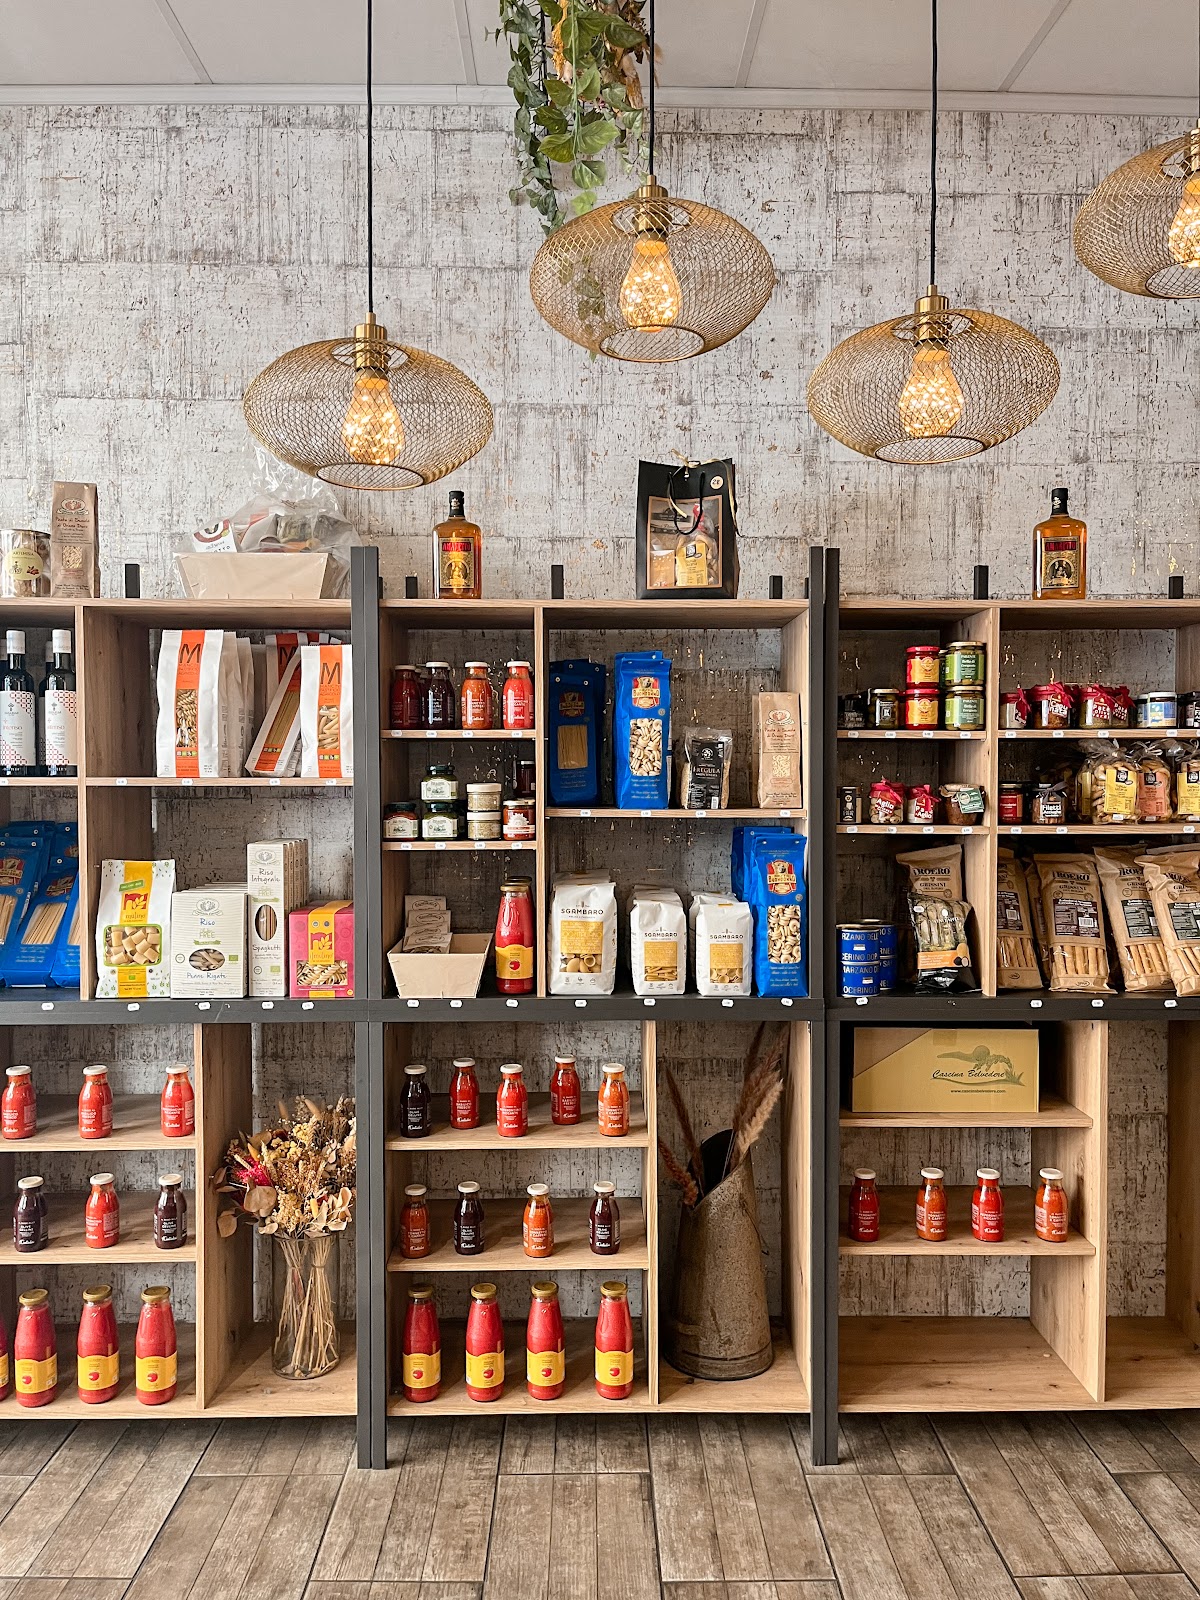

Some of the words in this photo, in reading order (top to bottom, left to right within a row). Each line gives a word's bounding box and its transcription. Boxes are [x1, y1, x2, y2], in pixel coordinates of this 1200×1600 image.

[180, 644, 201, 663] M
[320, 662, 341, 684] M
[932, 1069, 964, 1078] Cascina
[968, 1069, 1005, 1077] Belvedere
